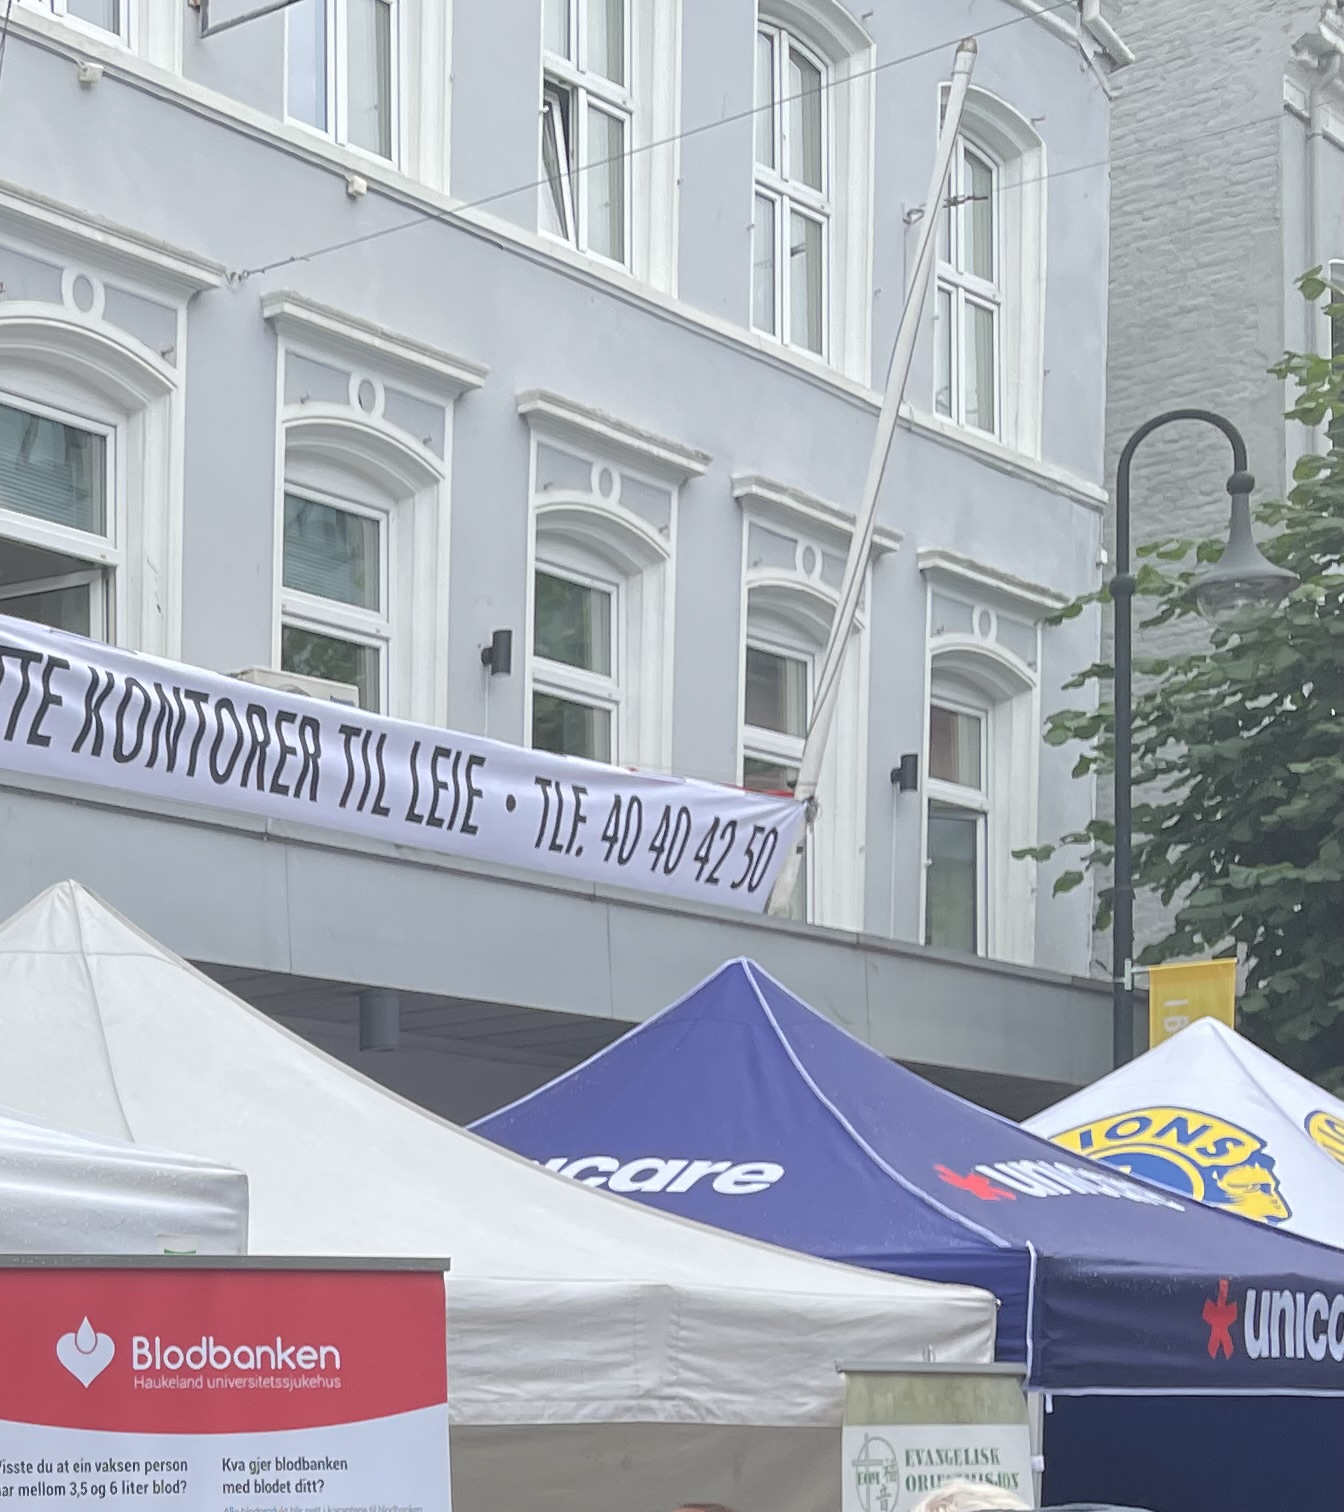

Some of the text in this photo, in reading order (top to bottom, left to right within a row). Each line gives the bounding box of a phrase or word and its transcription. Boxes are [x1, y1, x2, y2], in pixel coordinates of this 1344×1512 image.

[72, 665, 321, 801] KONTORER
[337, 723, 392, 818] TIL
[405, 741, 486, 836] LEIE
[533, 776, 588, 857] TLF.
[601, 795, 644, 865] 40
[650, 804, 695, 875] 40
[692, 816, 744, 886] 42
[732, 828, 776, 893] 50
[1080, 1116, 1242, 1163] IONS
[131, 1336, 341, 1371] Blodbanken
[133, 1375, 341, 1392] Haukeland universitetssjukehus
[37, 1459, 53, 1474] du
[56, 1460, 70, 1473] at
[73, 1458, 91, 1473] ein
[95, 1458, 140, 1473] vaksen
[144, 1459, 188, 1475] person
[222, 1456, 348, 1475] Kva gjer blodbanken
[905, 1448, 1000, 1467] EVANGELISK
[18, 1482, 65, 1496] mellom
[70, 1482, 87, 1499] 3,5
[90, 1485, 105, 1499] og
[110, 1481, 117, 1494] 6
[122, 1480, 149, 1494] liter
[153, 1480, 187, 1494] blod?
[222, 1479, 324, 1494] med blodet ditt?
